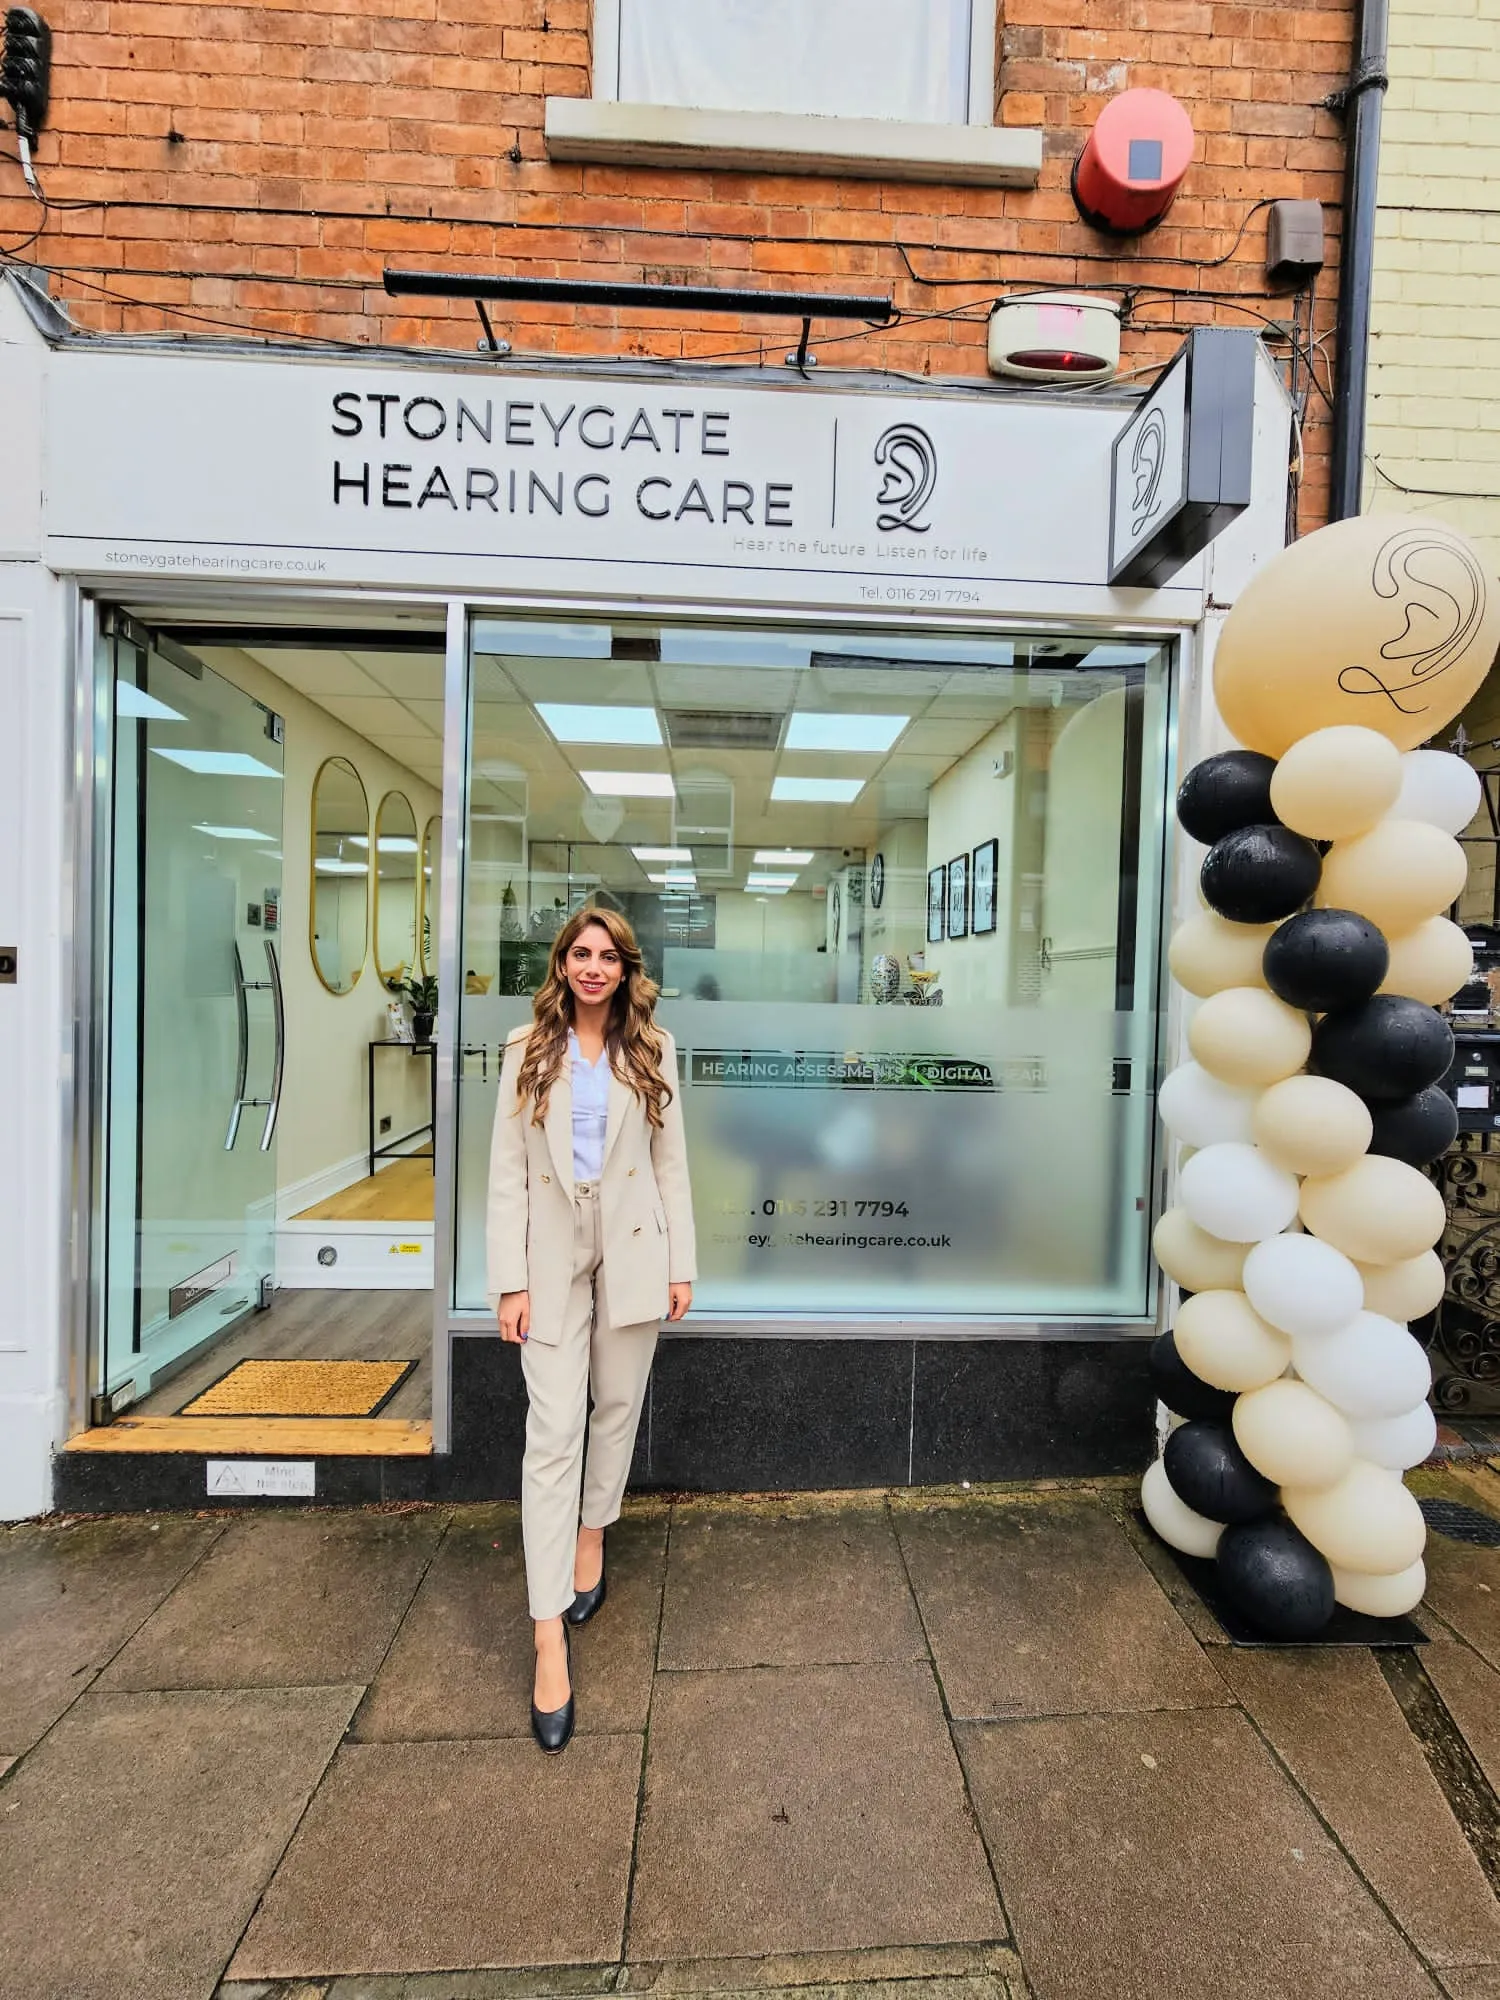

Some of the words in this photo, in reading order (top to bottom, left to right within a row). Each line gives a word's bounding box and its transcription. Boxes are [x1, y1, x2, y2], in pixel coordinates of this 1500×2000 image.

[331, 391, 730, 456] STONEYGATE
[332, 460, 610, 516] HEARING
[636, 476, 794, 527] CARE
[733, 536, 774, 551] Hear
[778, 538, 807, 553] the
[813, 540, 865, 556] future
[876, 542, 927, 559] Listen
[933, 546, 957, 560] for
[961, 546, 988, 561] life
[105, 550, 328, 572] stoneygatehearingcare.co.uk
[860, 586, 882, 600] Tel.
[886, 587, 916, 601] 0116
[919, 588, 942, 602] 291
[944, 589, 981, 603] 7794
[701, 1061, 780, 1077] HEARING
[926, 1066, 993, 1082] DIGITAL
[854, 1200, 910, 1218] 7794
